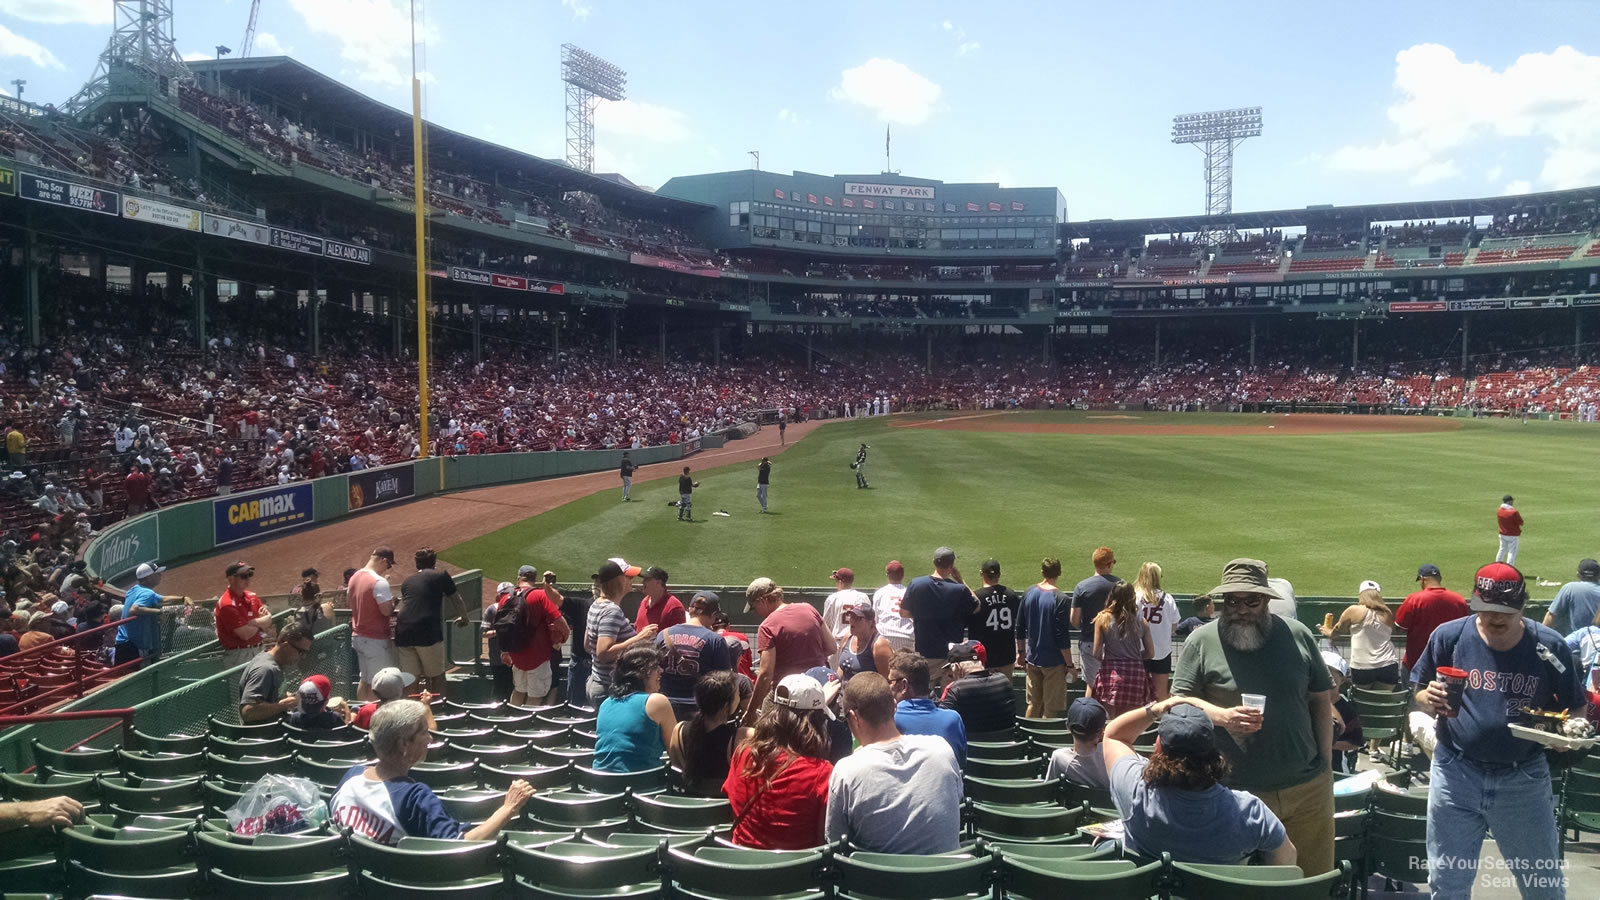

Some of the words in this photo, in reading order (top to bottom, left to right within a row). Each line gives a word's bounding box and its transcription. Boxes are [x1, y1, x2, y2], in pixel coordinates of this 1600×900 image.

[35, 180, 49, 190] The
[50, 183, 63, 193] Sox
[69, 185, 94, 201] WEEI
[851, 185, 894, 195] FENWAY
[900, 187, 929, 197] PARK
[38, 191, 50, 199] are
[51, 193, 61, 201] on
[327, 243, 343, 257] ALEX
[343, 246, 357, 259] AND
[375, 478, 399, 499] KAYEM
[100, 533, 140, 577] Jordan's
[985, 594, 1007, 606] SALE
[986, 607, 1012, 630] 49
[1465, 669, 1540, 697] OSTON
